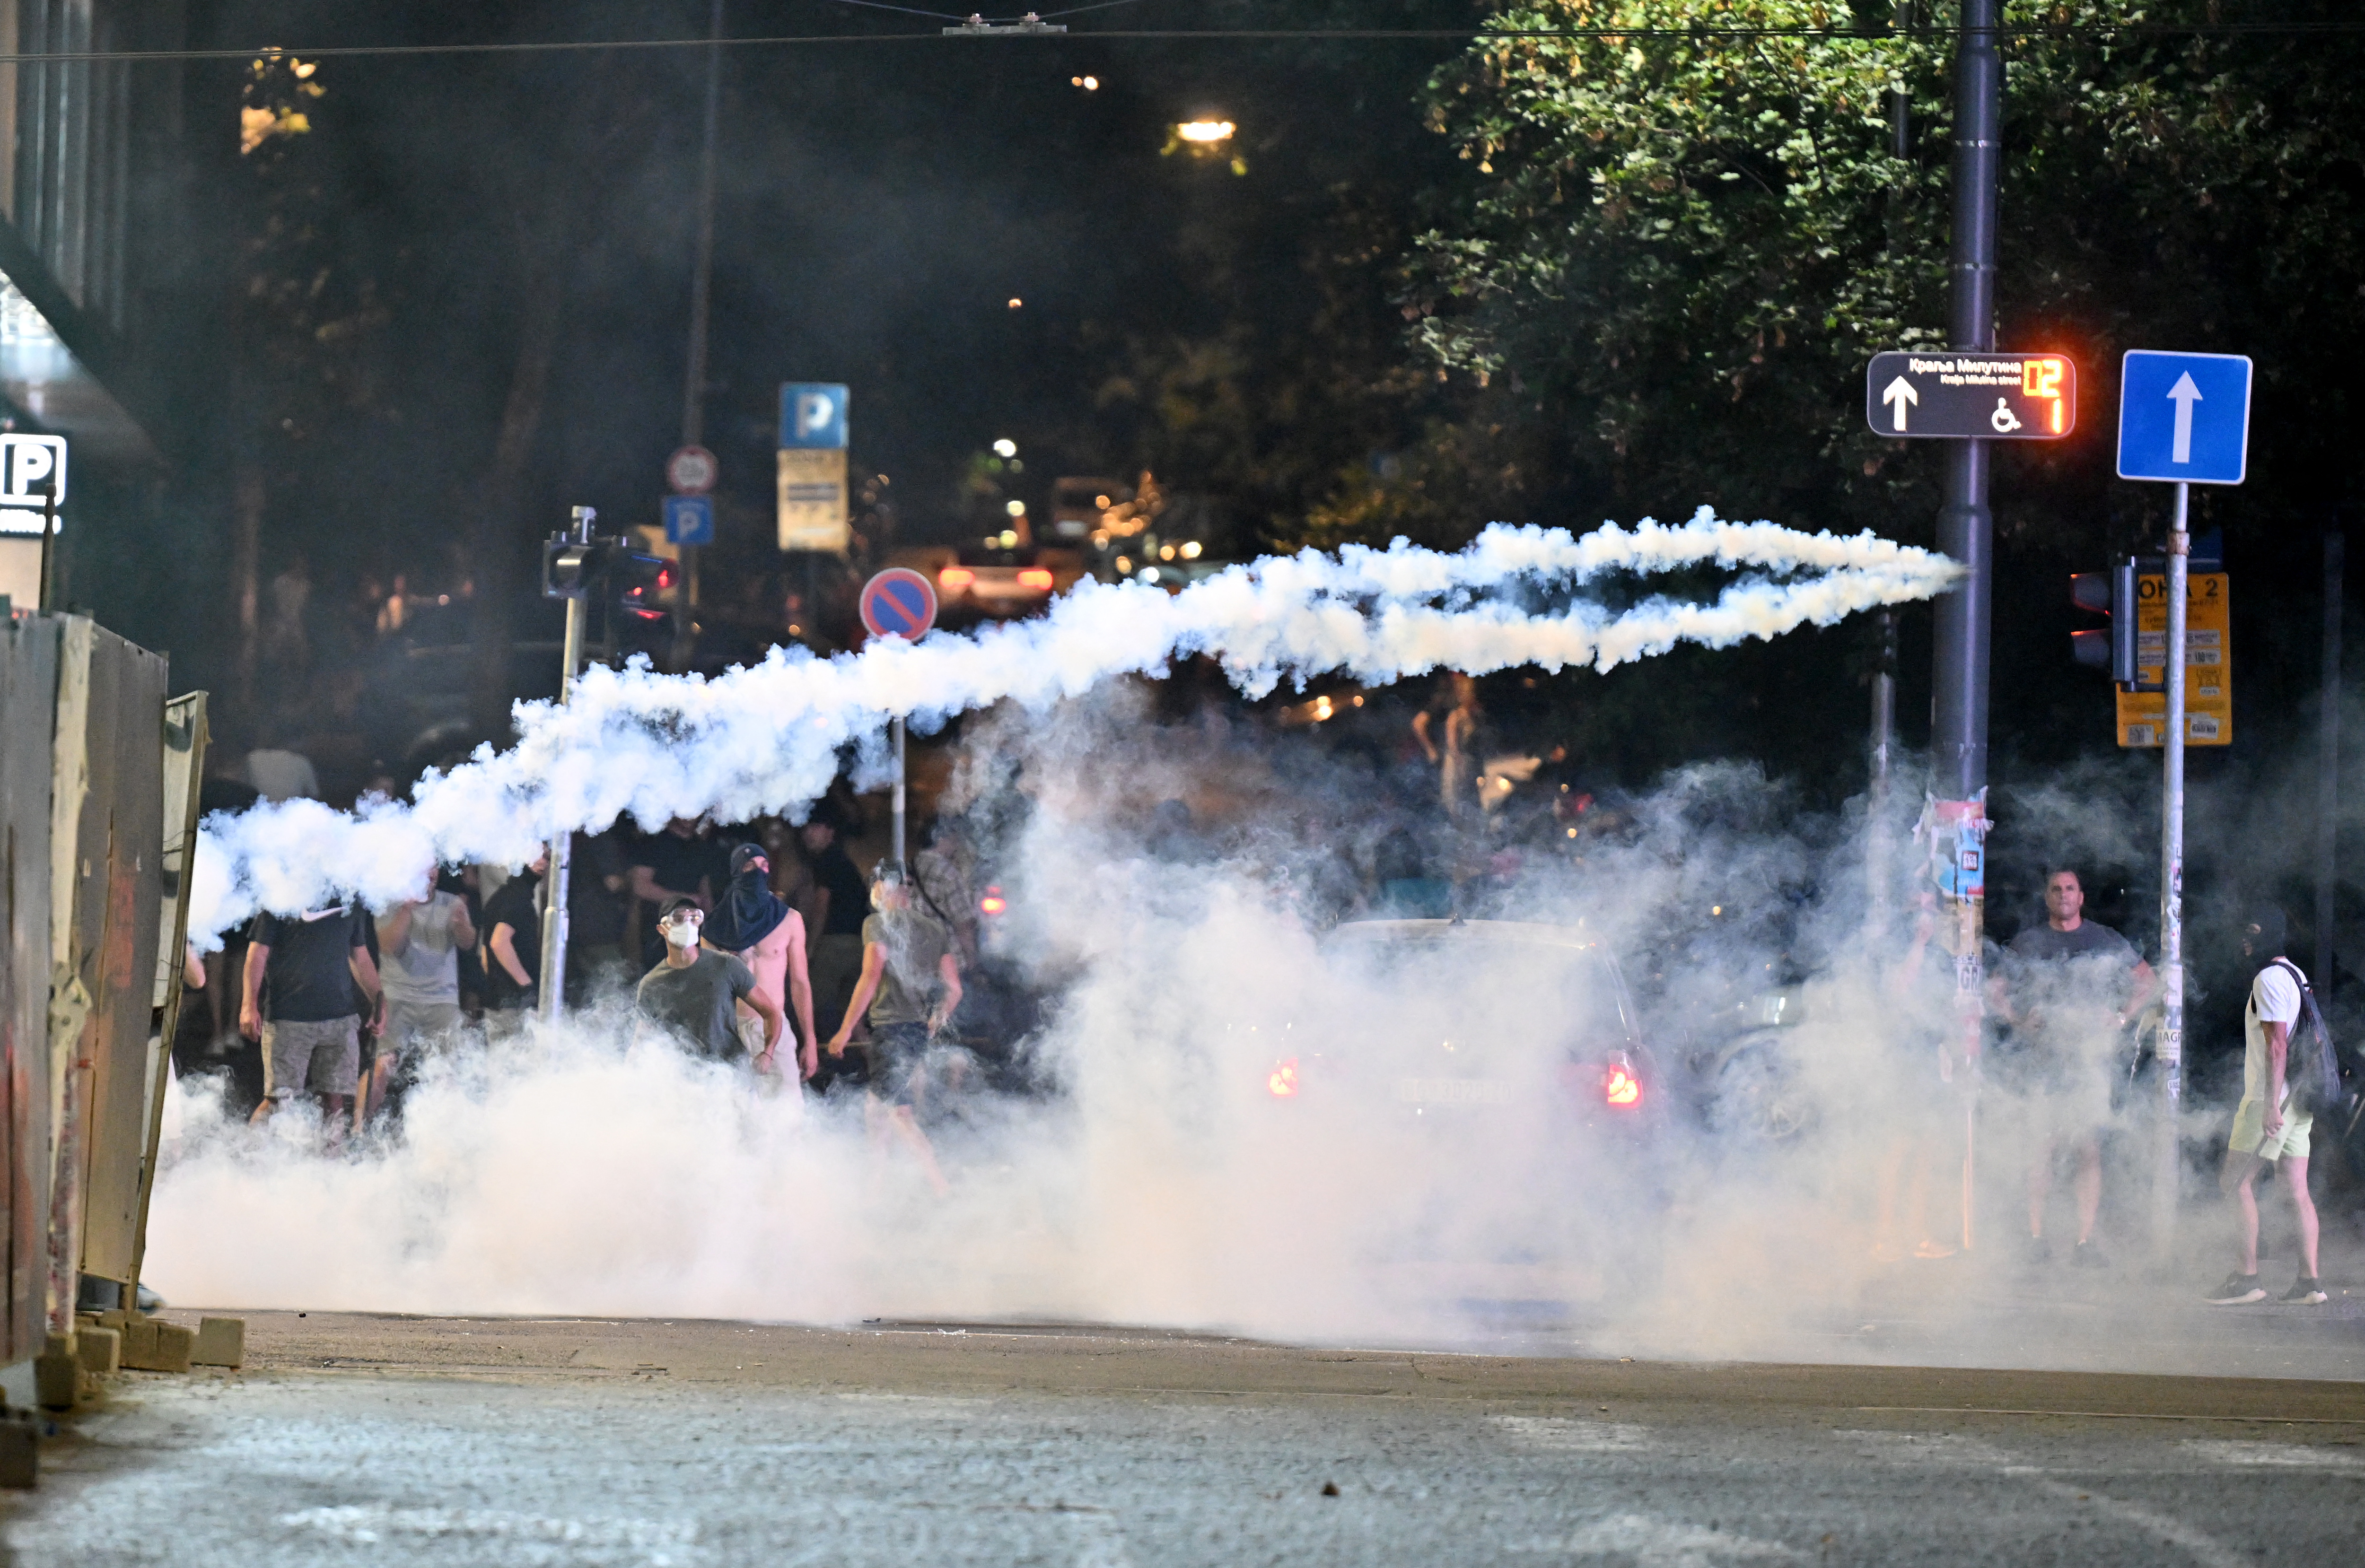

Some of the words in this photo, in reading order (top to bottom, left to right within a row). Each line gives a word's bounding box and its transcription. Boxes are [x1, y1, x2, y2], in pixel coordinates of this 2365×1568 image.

[1910, 358, 1954, 375] Краља
[1957, 359, 2022, 375] Милутина
[1940, 374, 1964, 386] Kralja
[1965, 375, 1997, 385] Milutina
[1998, 376, 2022, 385] street
[2023, 360, 2062, 397] 02
[13, 444, 52, 496] P
[2206, 578, 2218, 597] 2
